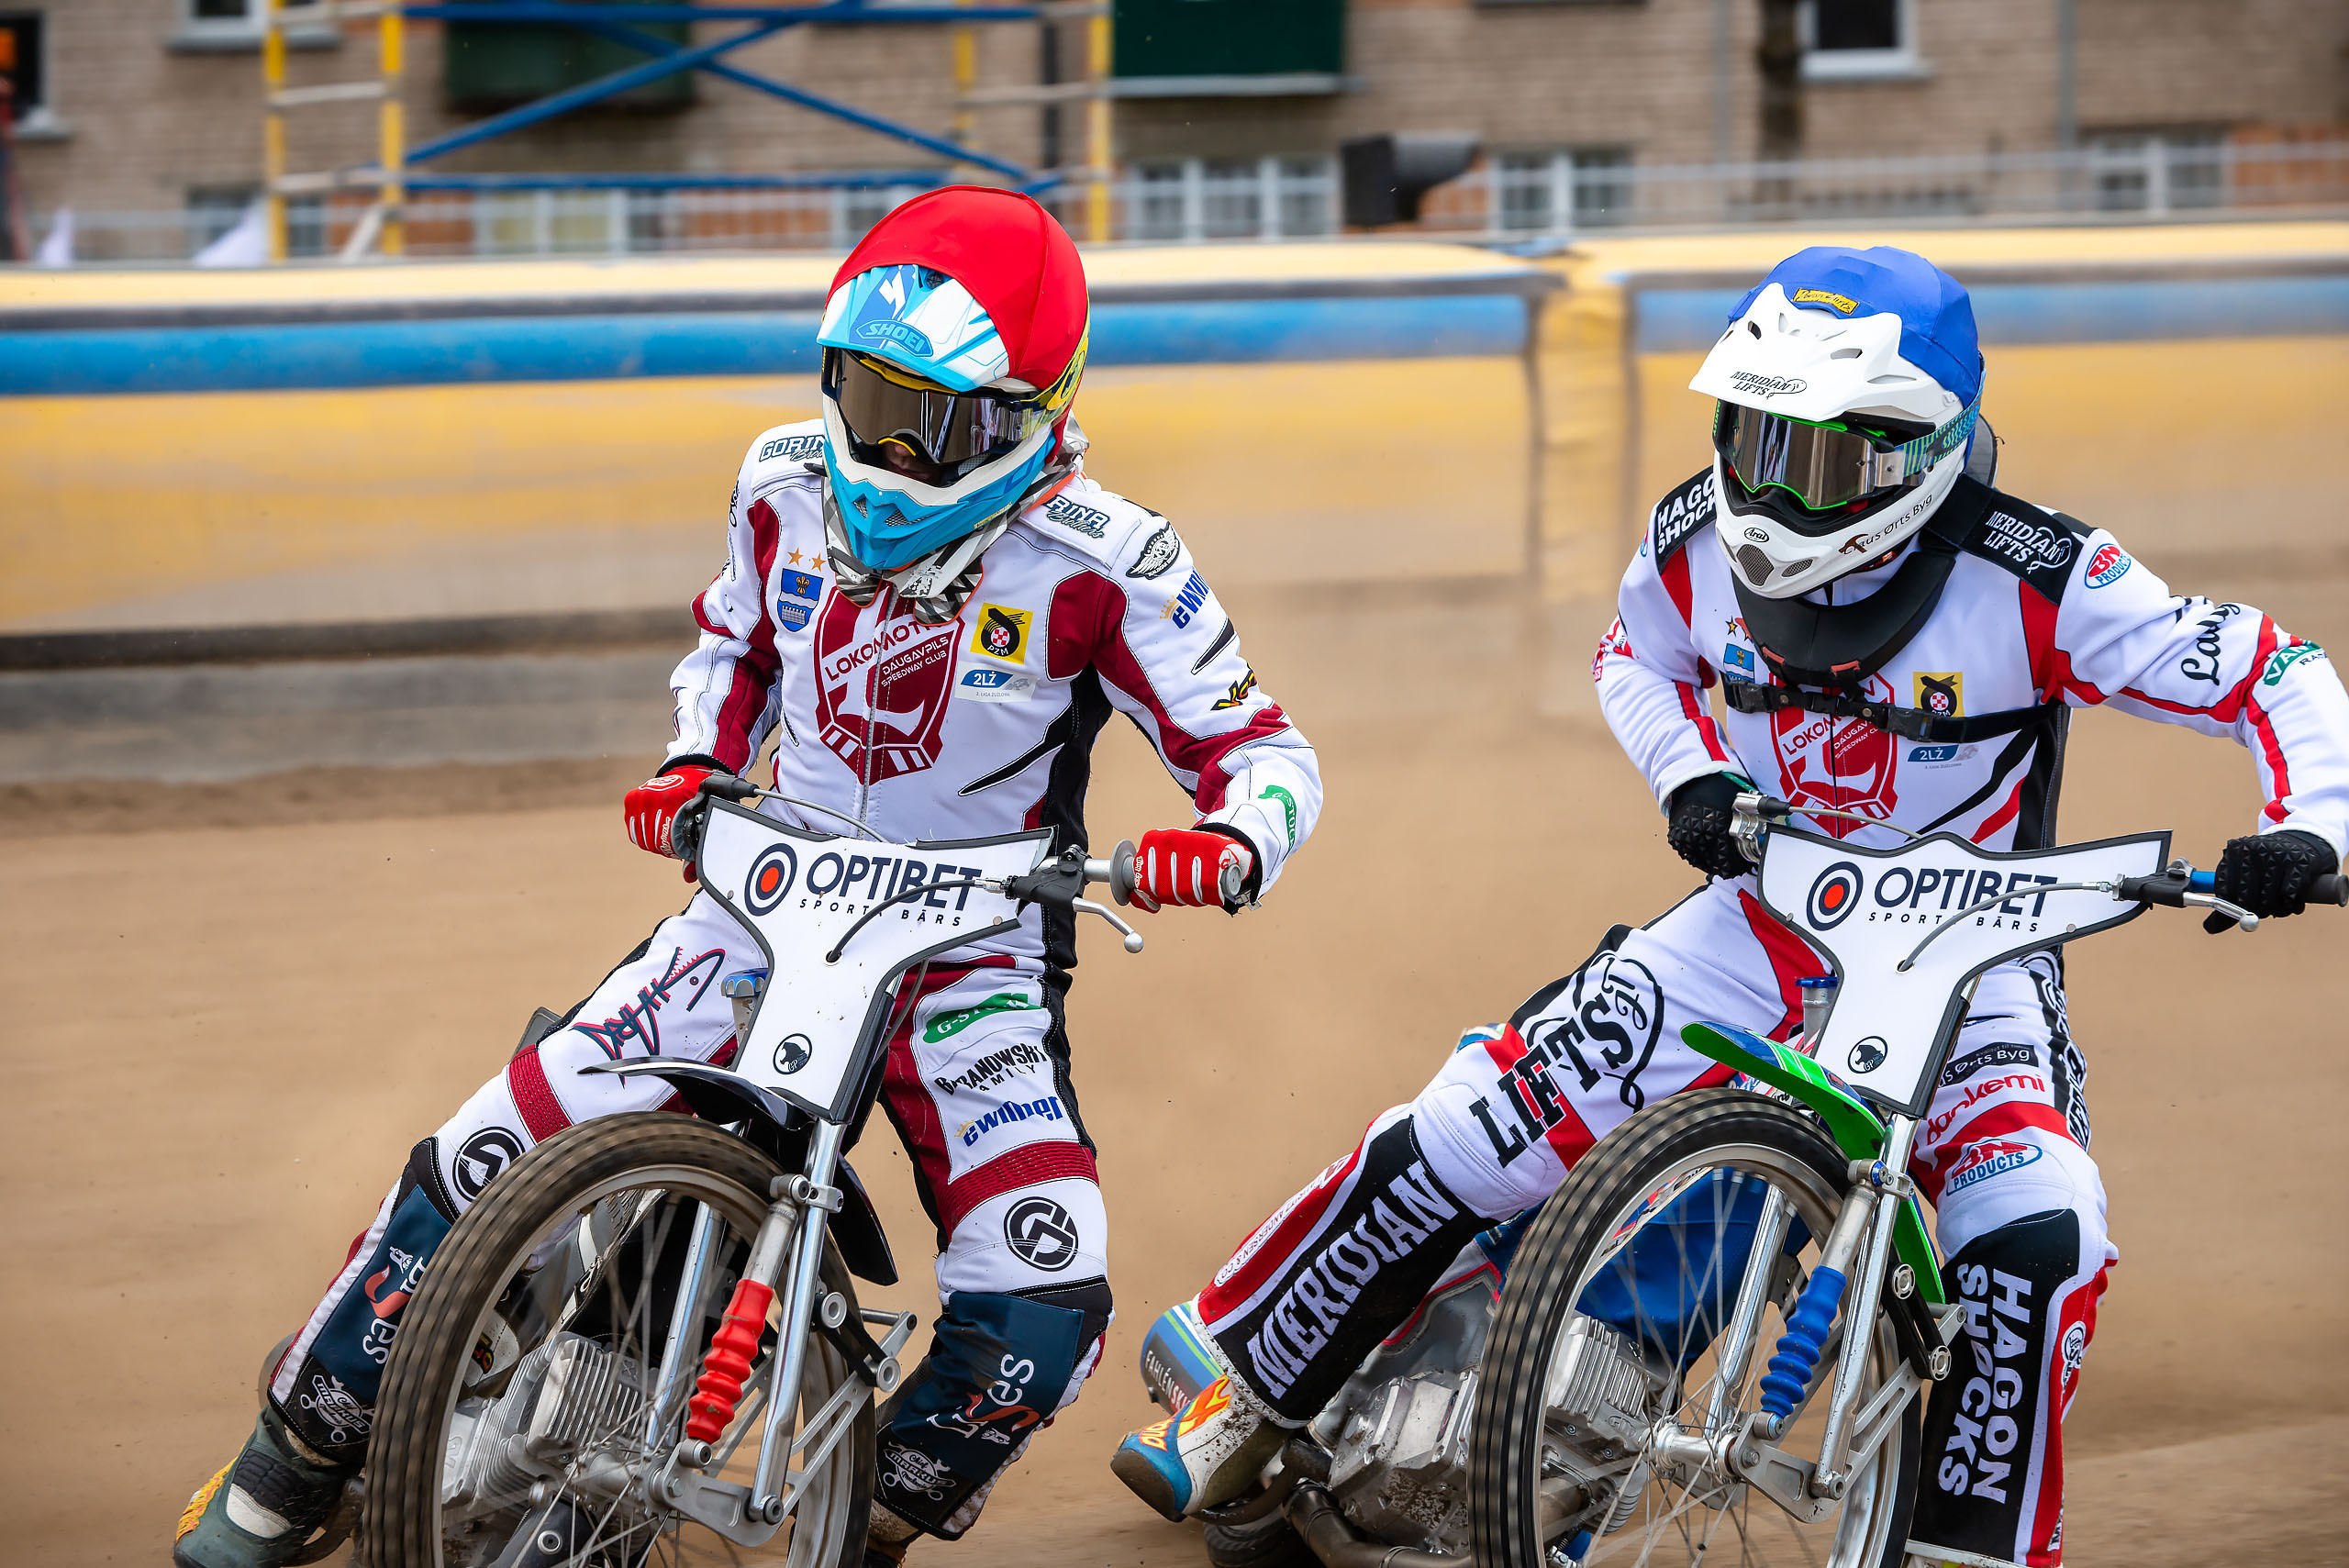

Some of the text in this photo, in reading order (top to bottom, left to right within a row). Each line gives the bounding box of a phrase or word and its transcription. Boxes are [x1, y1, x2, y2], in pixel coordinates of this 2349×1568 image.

[865, 323, 926, 352] SHOEI
[1730, 371, 1791, 391] MERIDIAN
[1732, 381, 1770, 395] LIFTS
[759, 434, 826, 462] GORIN
[1657, 472, 1715, 530] HAGO
[1884, 514, 1910, 536] Ørts
[1912, 494, 1932, 516] Byg
[1983, 529, 2033, 562] LIFTS
[1986, 510, 2061, 562] MERIDIAN
[881, 651, 947, 688] SPEEDWAY CLUB
[882, 636, 950, 674] DAUGAVPILS
[986, 645, 1009, 657] PZM
[973, 671, 997, 686] 2LŻ
[1920, 748, 1943, 761] 2LŻ
[806, 851, 982, 912] OPTIBET
[1874, 866, 2058, 917] OPTIBET
[1997, 1048, 2030, 1061] Byg
[1468, 992, 1634, 1170] LIFTS
[1953, 1151, 2025, 1187] PRODUCTS
[1246, 1160, 1459, 1400] MERIDIAN
[1938, 1263, 1994, 1496] SHOCKS
[1971, 1268, 2032, 1504] HAGON
